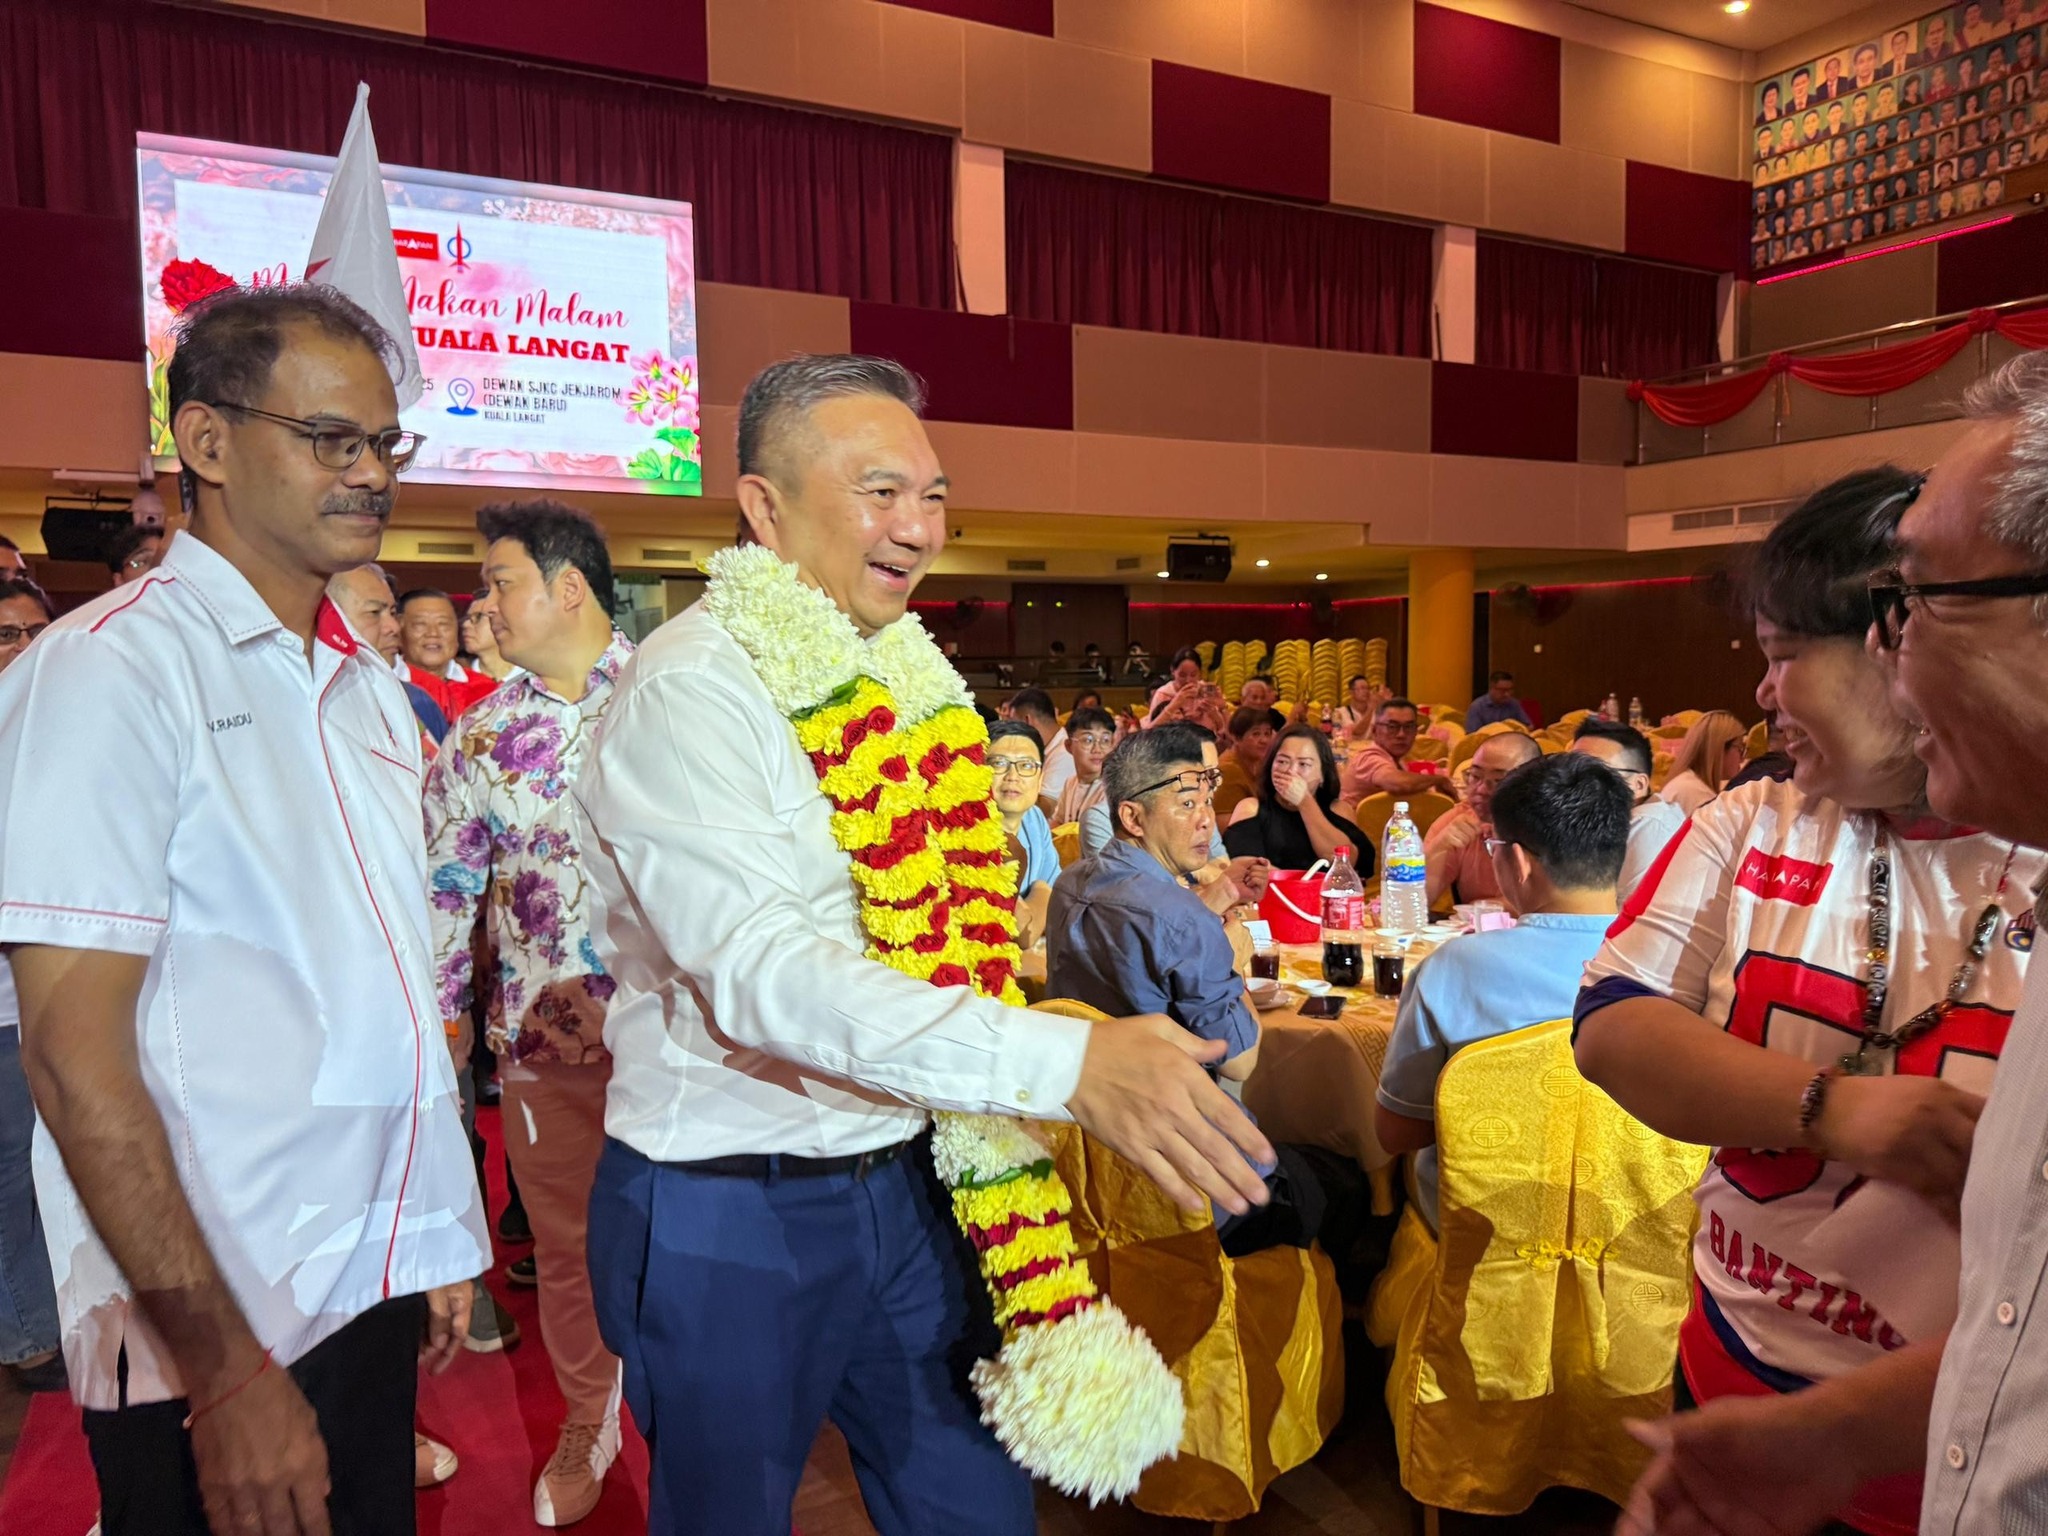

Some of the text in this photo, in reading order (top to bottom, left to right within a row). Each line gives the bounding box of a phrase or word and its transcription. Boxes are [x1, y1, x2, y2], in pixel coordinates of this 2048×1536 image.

[515, 288, 630, 329] Malam
[411, 326, 630, 363] UALA LANGAT
